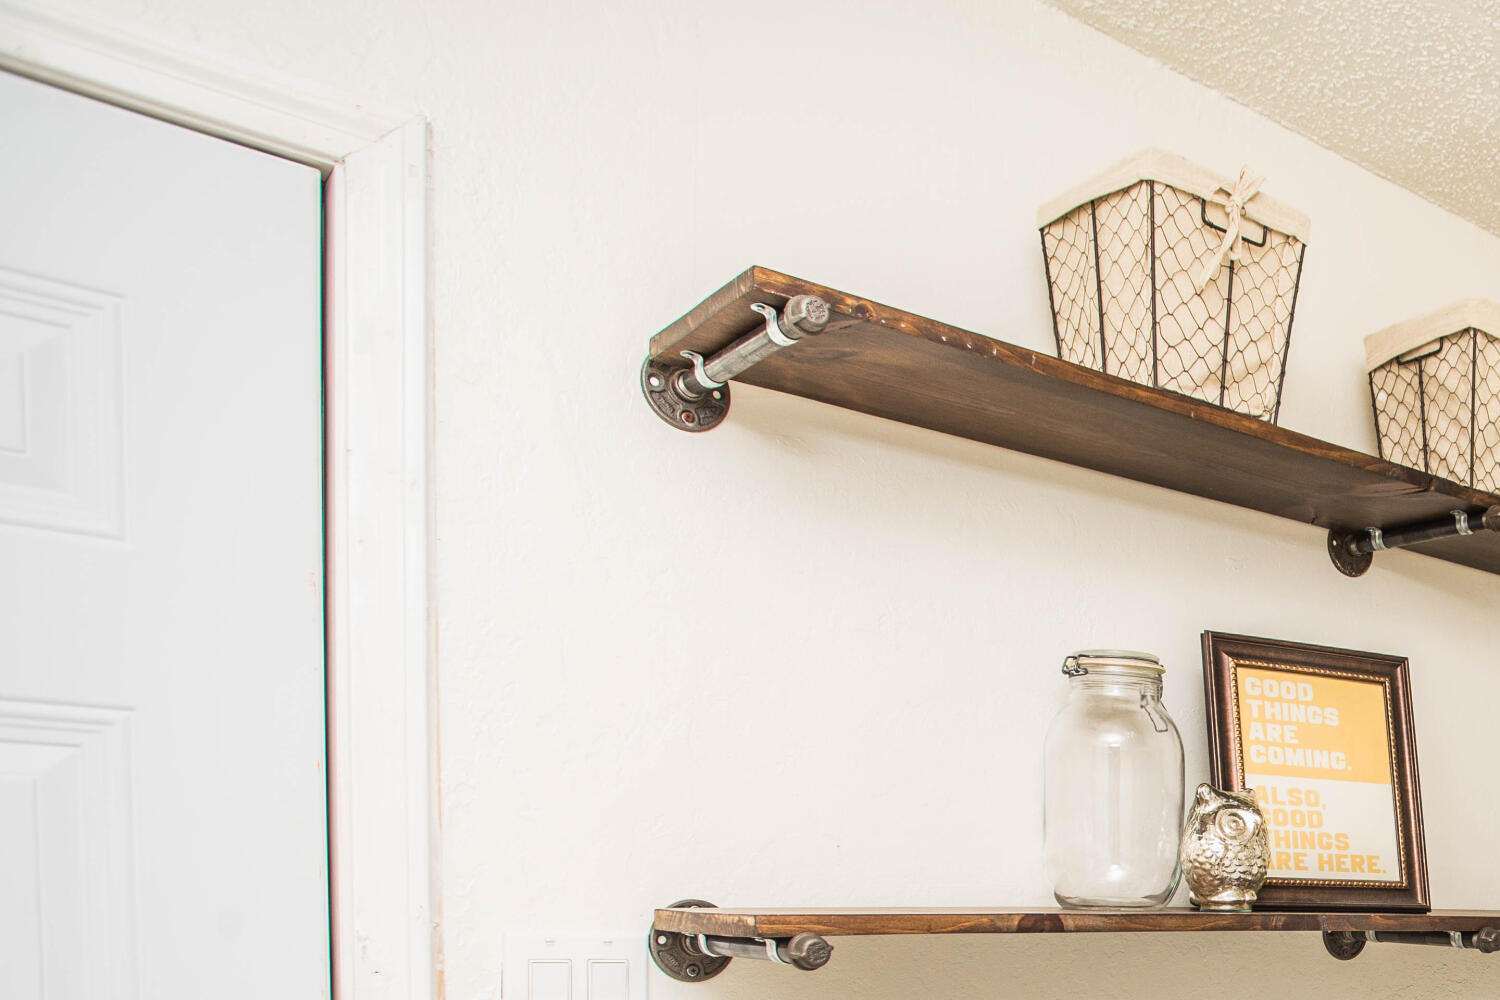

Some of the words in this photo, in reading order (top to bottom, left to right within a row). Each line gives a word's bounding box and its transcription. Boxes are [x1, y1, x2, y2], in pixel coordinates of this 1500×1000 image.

[1245, 677, 1313, 701] GOOD
[1246, 698, 1339, 726] THINGS
[1249, 721, 1298, 744] ARE
[1250, 744, 1352, 772] COMING.
[1255, 785, 1327, 811] ALSO,
[1268, 829, 1350, 851] HINGS
[1318, 853, 1387, 874] HERE.
